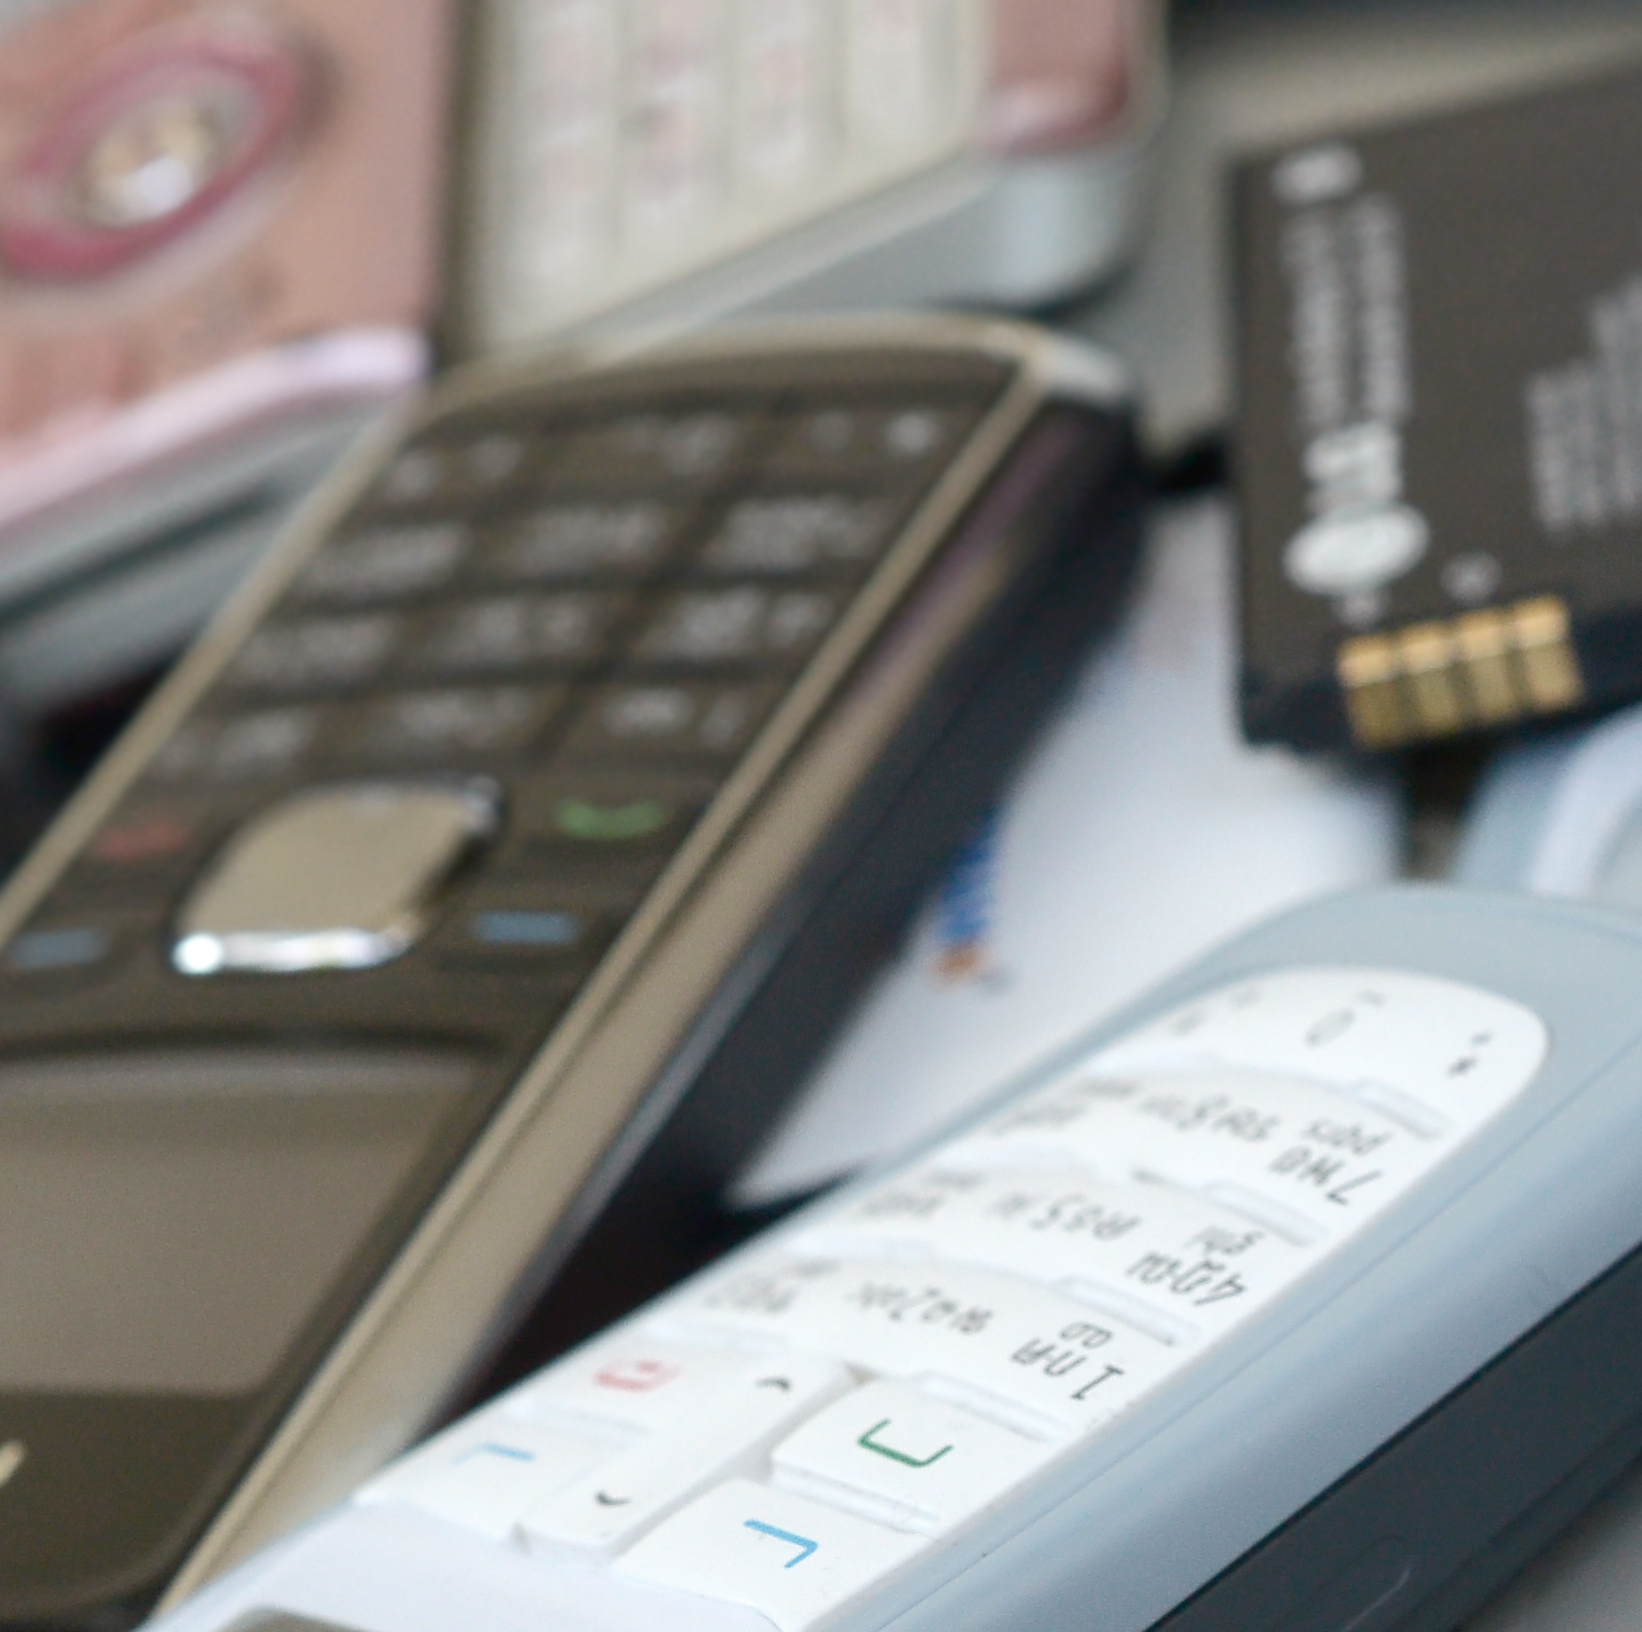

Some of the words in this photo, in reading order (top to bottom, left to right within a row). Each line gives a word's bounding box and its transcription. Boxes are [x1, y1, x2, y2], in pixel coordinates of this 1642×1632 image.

[1325, 1169, 1383, 1208] 7
[1192, 1273, 1247, 1307] 4
[1070, 1365, 1126, 1402] 1
